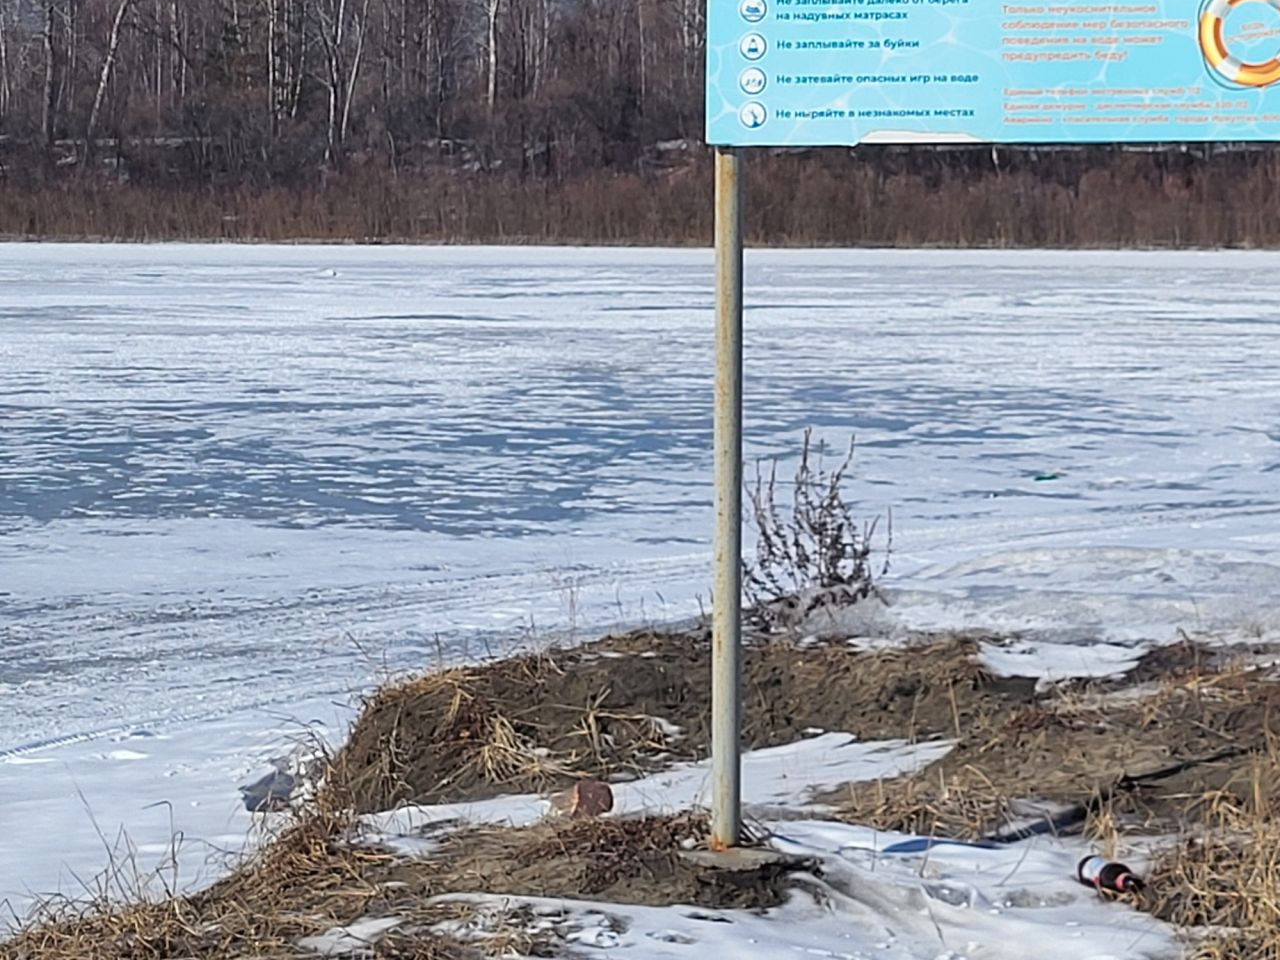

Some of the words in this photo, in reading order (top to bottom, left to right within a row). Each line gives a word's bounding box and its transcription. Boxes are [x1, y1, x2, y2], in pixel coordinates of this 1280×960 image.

[775, 12, 791, 21] на
[792, 12, 852, 22] надувных
[853, 11, 908, 21] матрасах
[776, 40, 793, 49] Не
[795, 39, 865, 49] заплывайте
[868, 40, 881, 49] за
[883, 38, 920, 50] буйки
[776, 74, 793, 84] Не
[794, 73, 854, 84] затевайте
[855, 75, 907, 83] опасных
[909, 74, 931, 85] игр
[933, 75, 948, 83] на
[950, 74, 980, 83] воде
[775, 109, 792, 119] Не
[794, 108, 846, 120] ныряйте
[857, 109, 931, 118] незнакомых
[933, 109, 975, 117] местах
